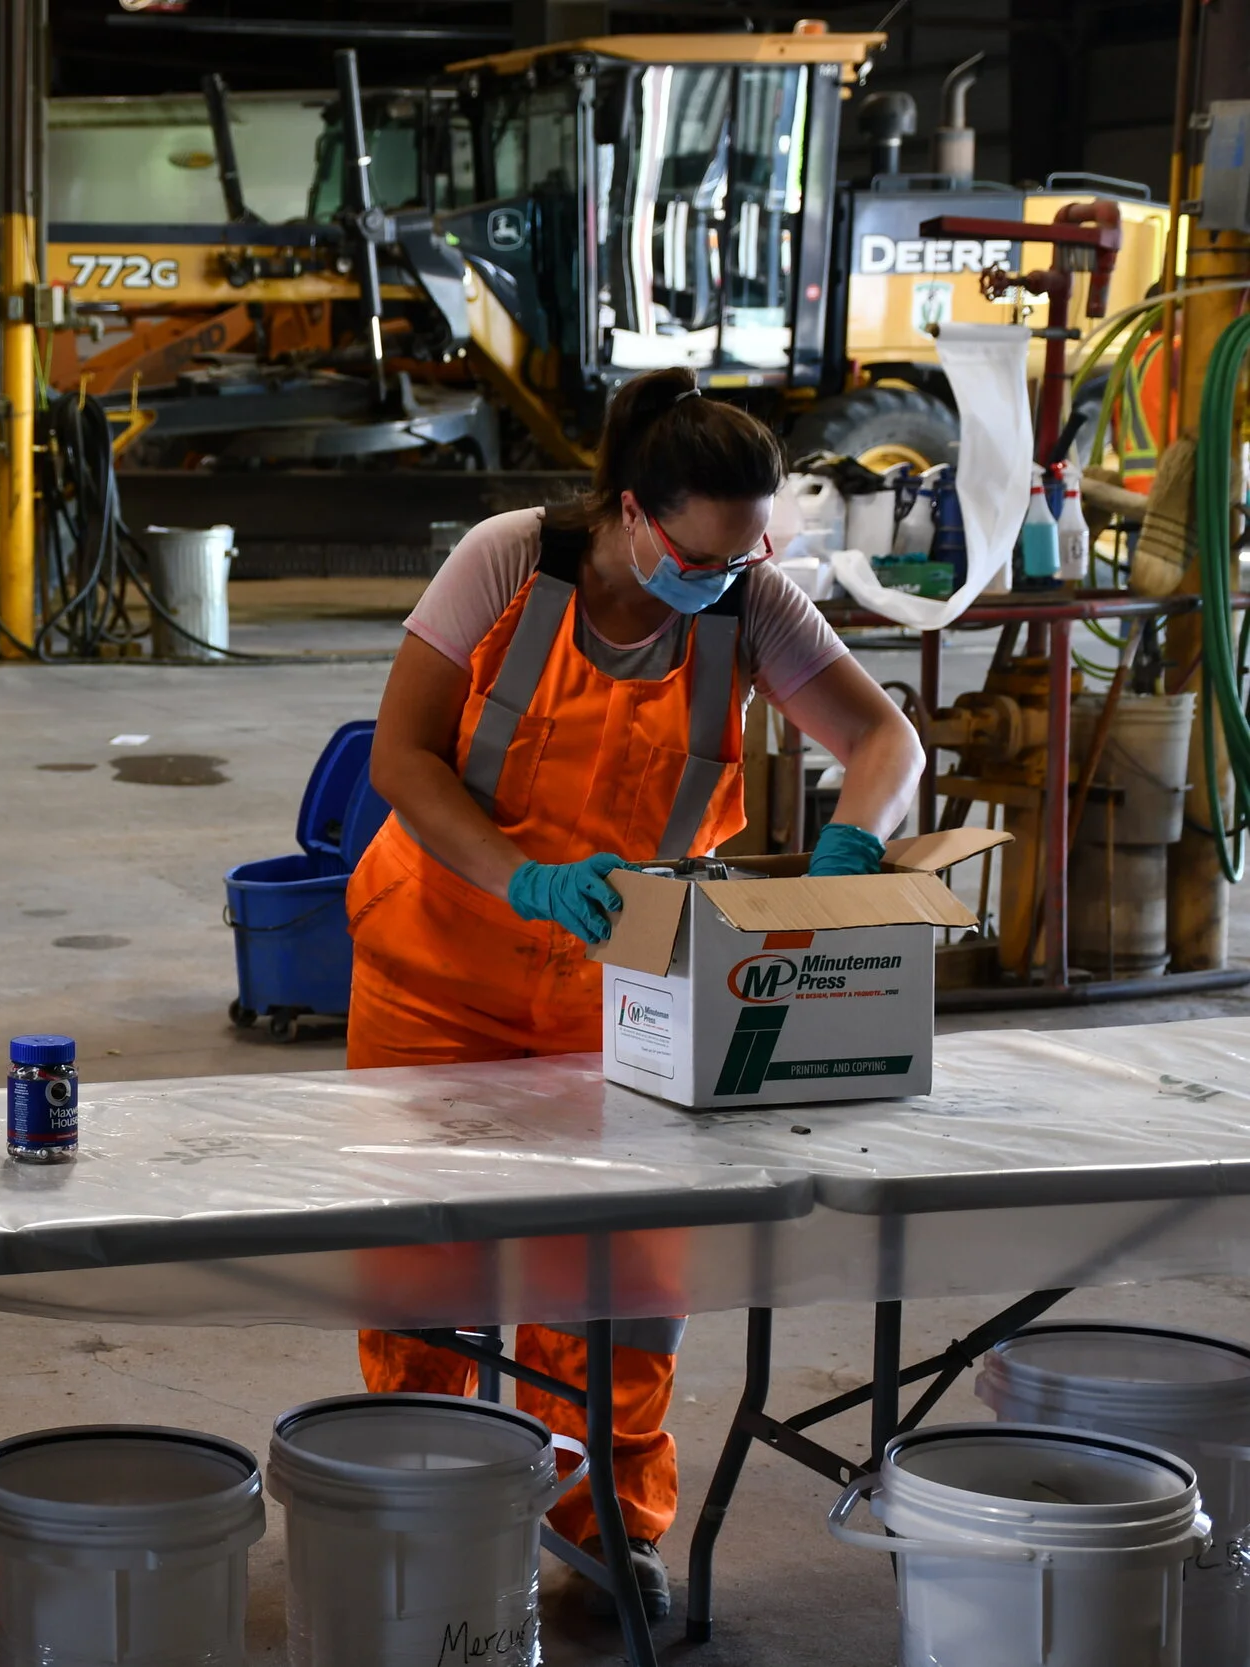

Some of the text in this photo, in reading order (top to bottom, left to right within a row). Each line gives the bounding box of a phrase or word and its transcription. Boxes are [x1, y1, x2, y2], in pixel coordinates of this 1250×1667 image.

[860, 234, 1012, 273] DEERE
[68, 254, 180, 289] 772G
[802, 955, 902, 972] Minuteman
[797, 973, 846, 990] Press
[643, 1014, 656, 1025] Press
[790, 1060, 887, 1076] PRINTING AND COPYING
